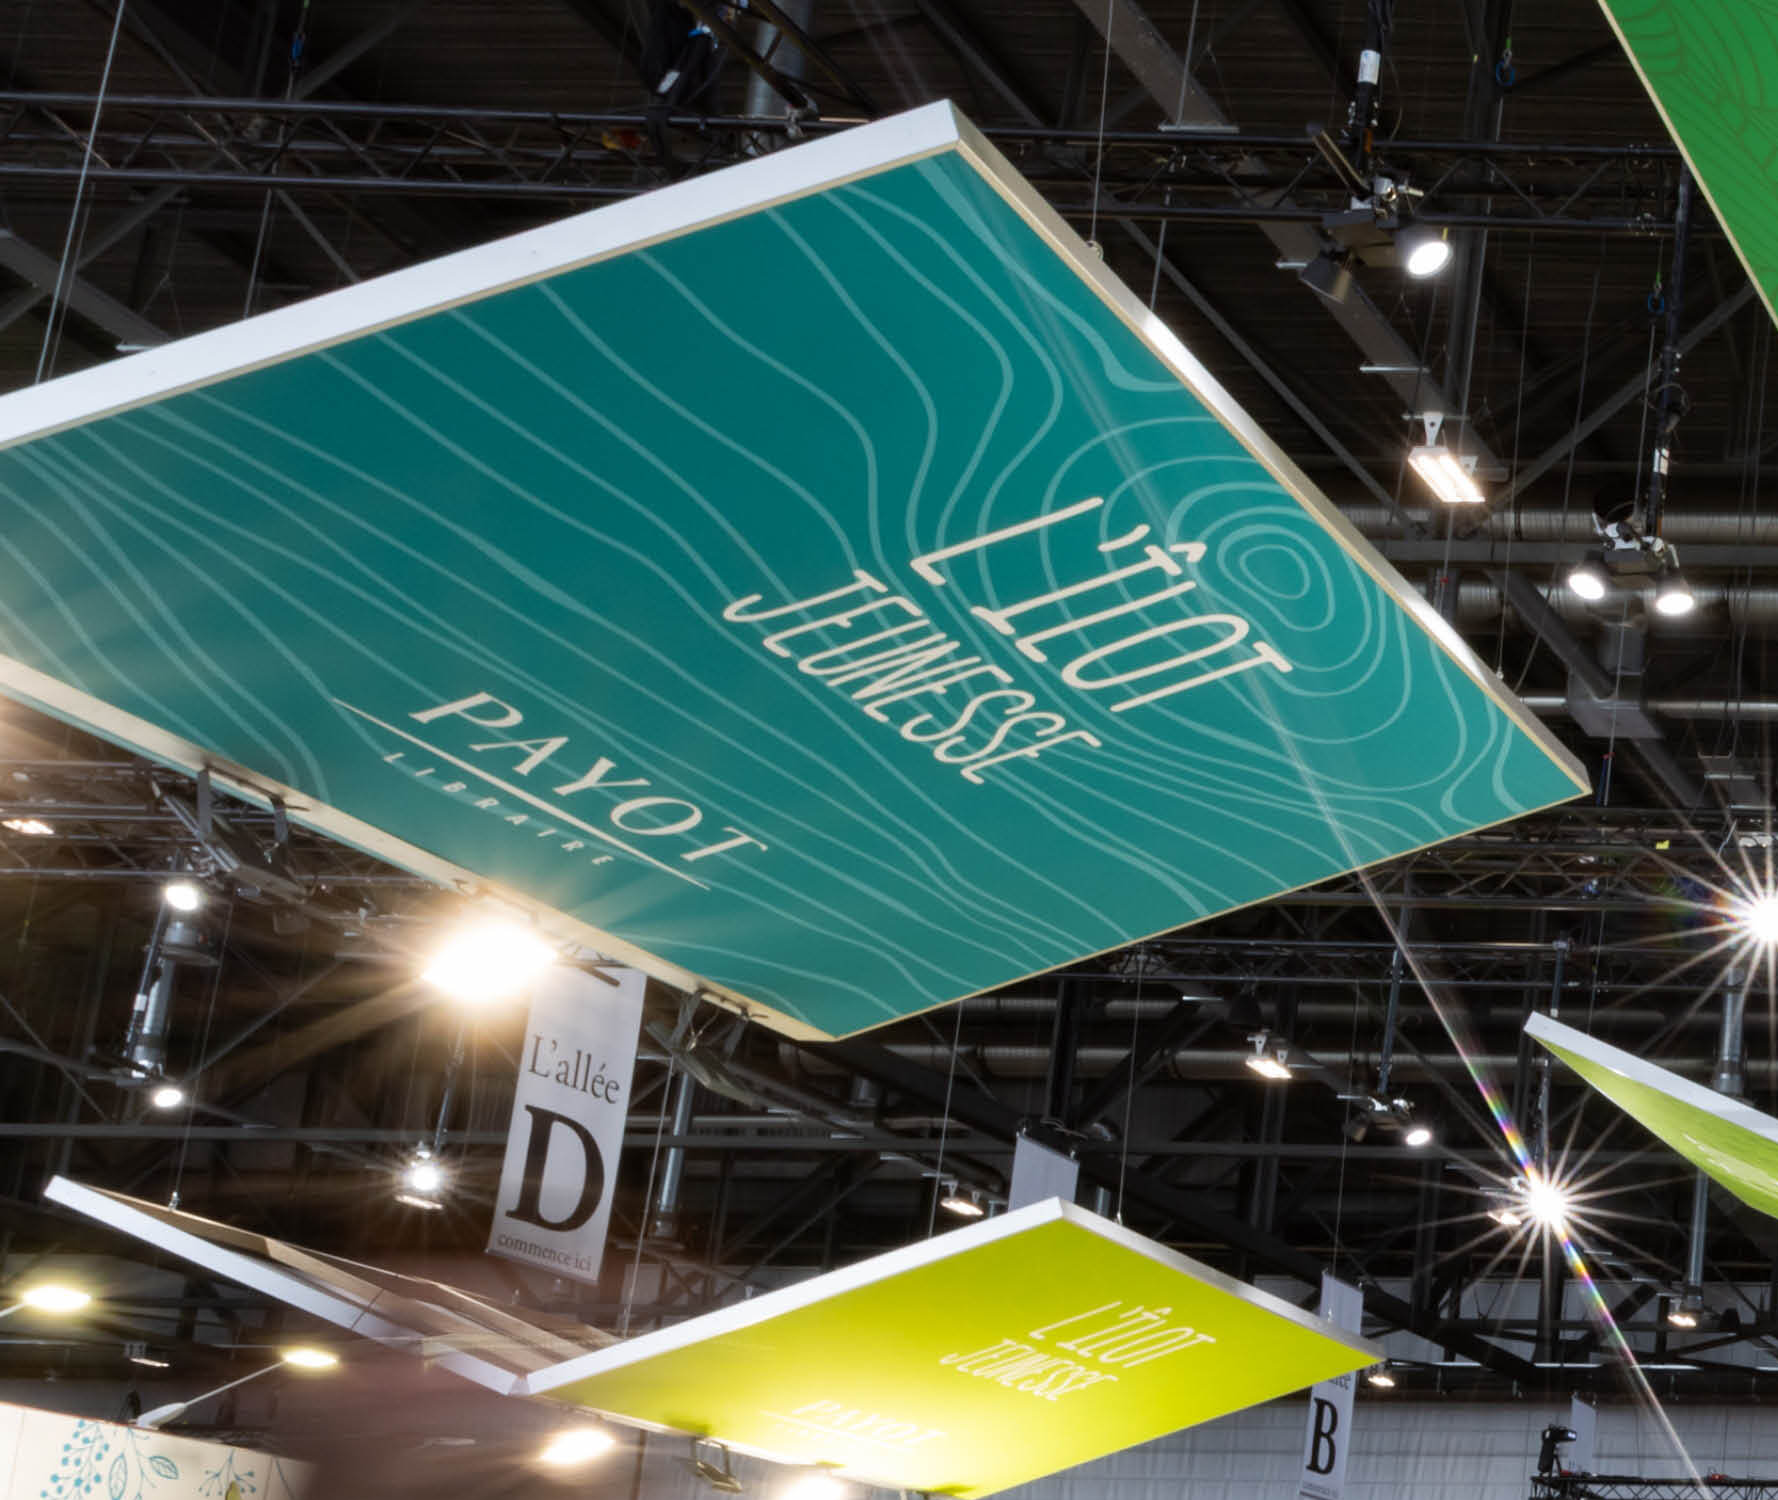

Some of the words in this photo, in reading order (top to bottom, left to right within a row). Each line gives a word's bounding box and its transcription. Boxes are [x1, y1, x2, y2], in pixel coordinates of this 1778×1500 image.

[910, 496, 1292, 713] L'ÎLOT
[723, 567, 1104, 787] JEUNESSE
[383, 752, 617, 867] LIBRAIRE
[408, 691, 768, 863] PAYOT
[528, 1033, 620, 1104] L'allée
[505, 1104, 604, 1232] D
[498, 1233, 570, 1267] commence
[574, 1255, 592, 1273] ici
[939, 1338, 1118, 1401] JEUNESSE
[1306, 1396, 1338, 1475] B
